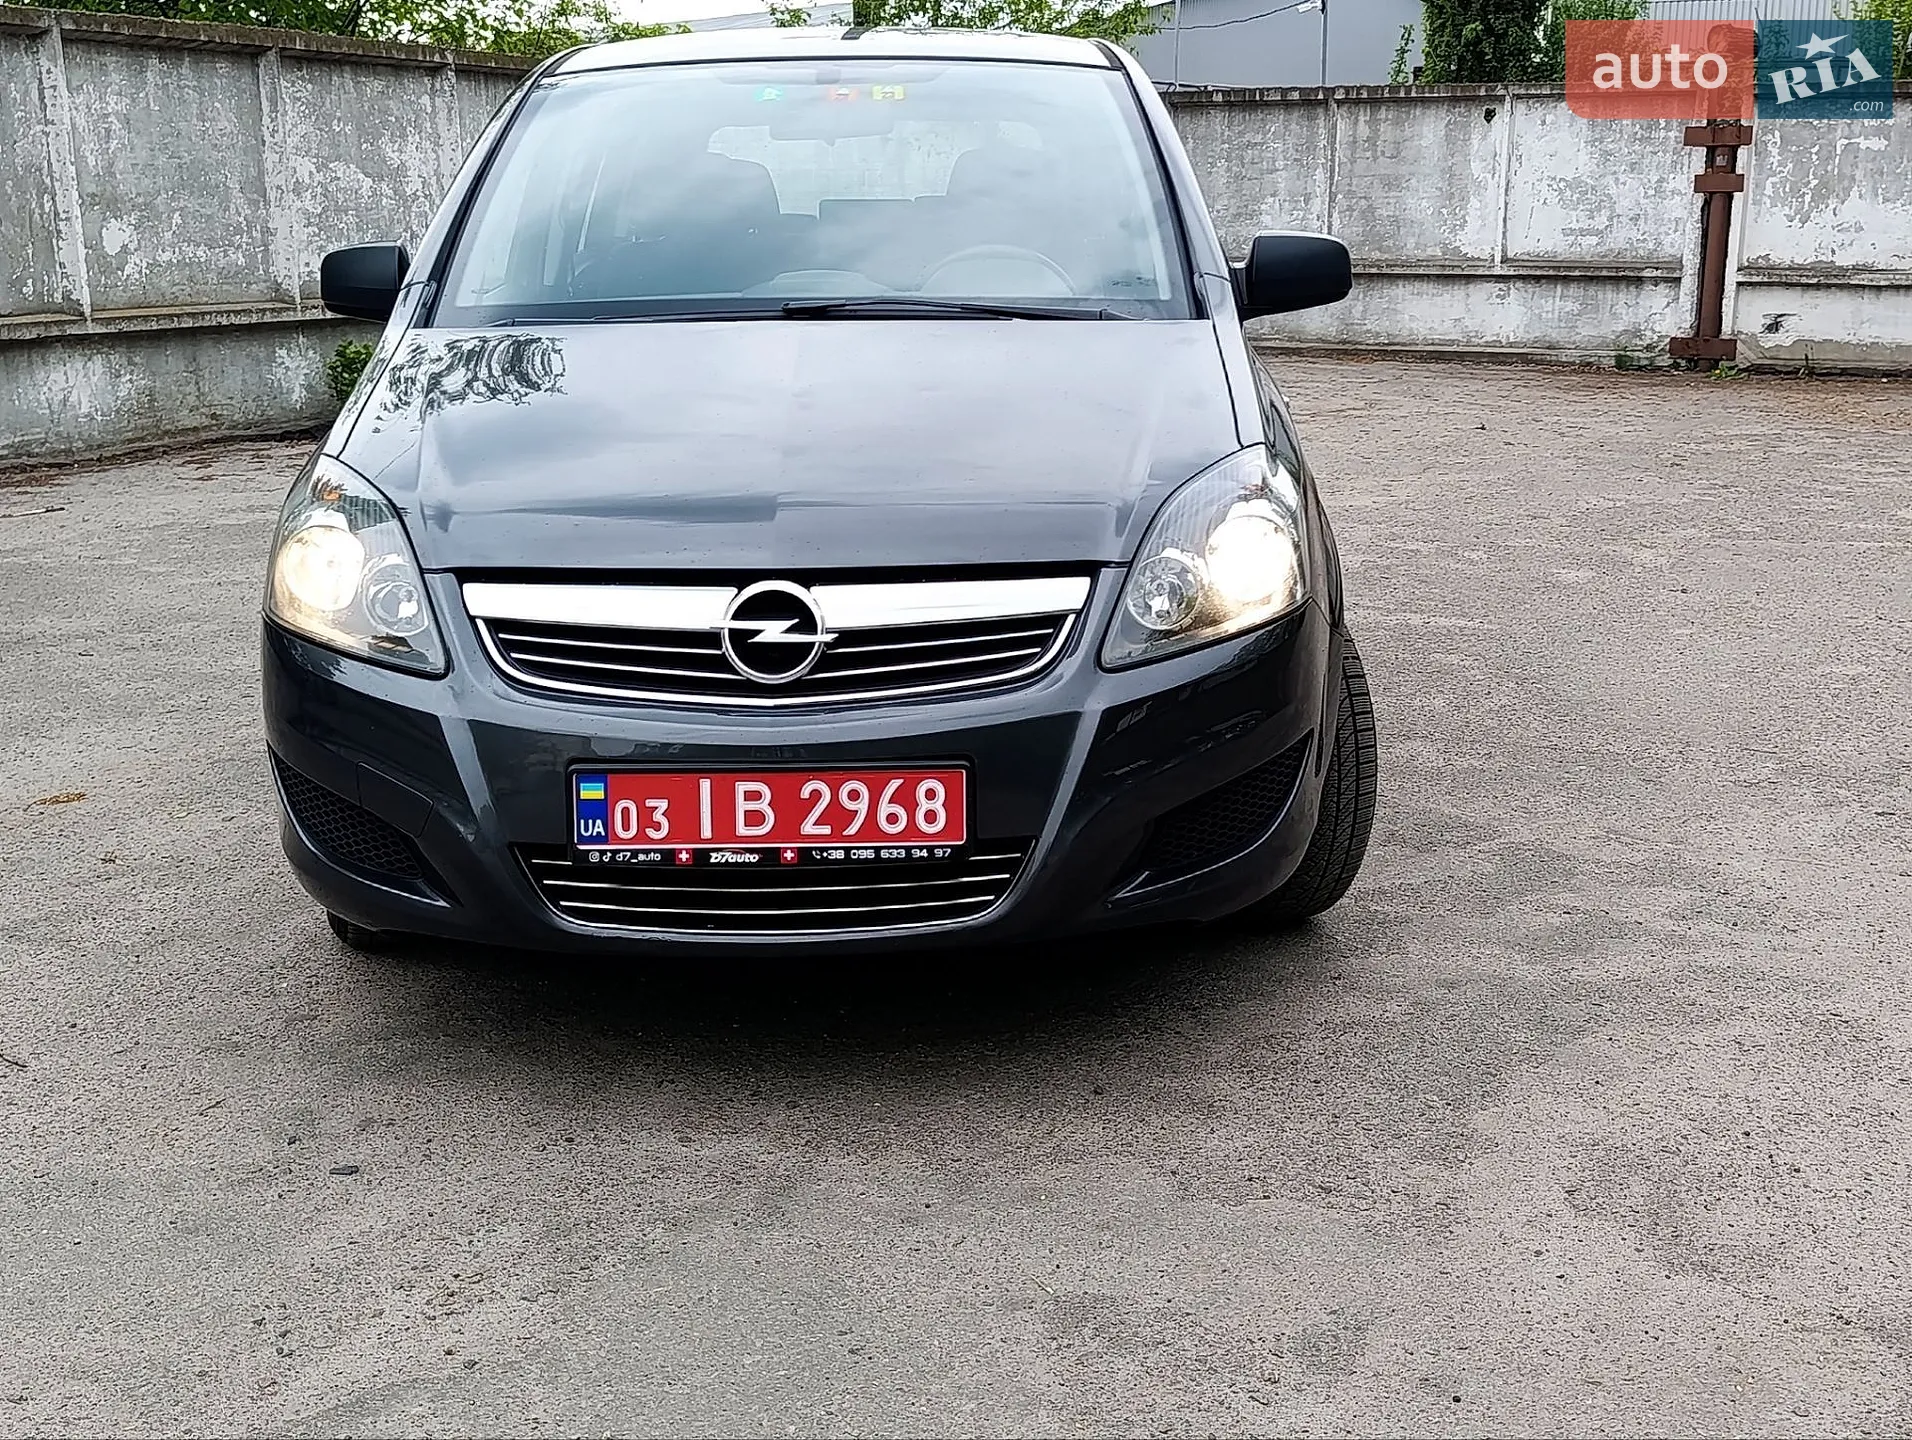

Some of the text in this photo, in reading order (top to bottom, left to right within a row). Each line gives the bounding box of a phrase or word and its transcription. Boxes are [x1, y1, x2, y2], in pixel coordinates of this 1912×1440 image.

[613, 799, 670, 840] 03
[800, 778, 948, 836] 2968
[580, 819, 605, 837] UA
[615, 852, 662, 863] d7_auto
[850, 849, 875, 859] 095
[880, 849, 906, 858] 633
[911, 848, 929, 858] 94
[934, 848, 951, 857] 97
